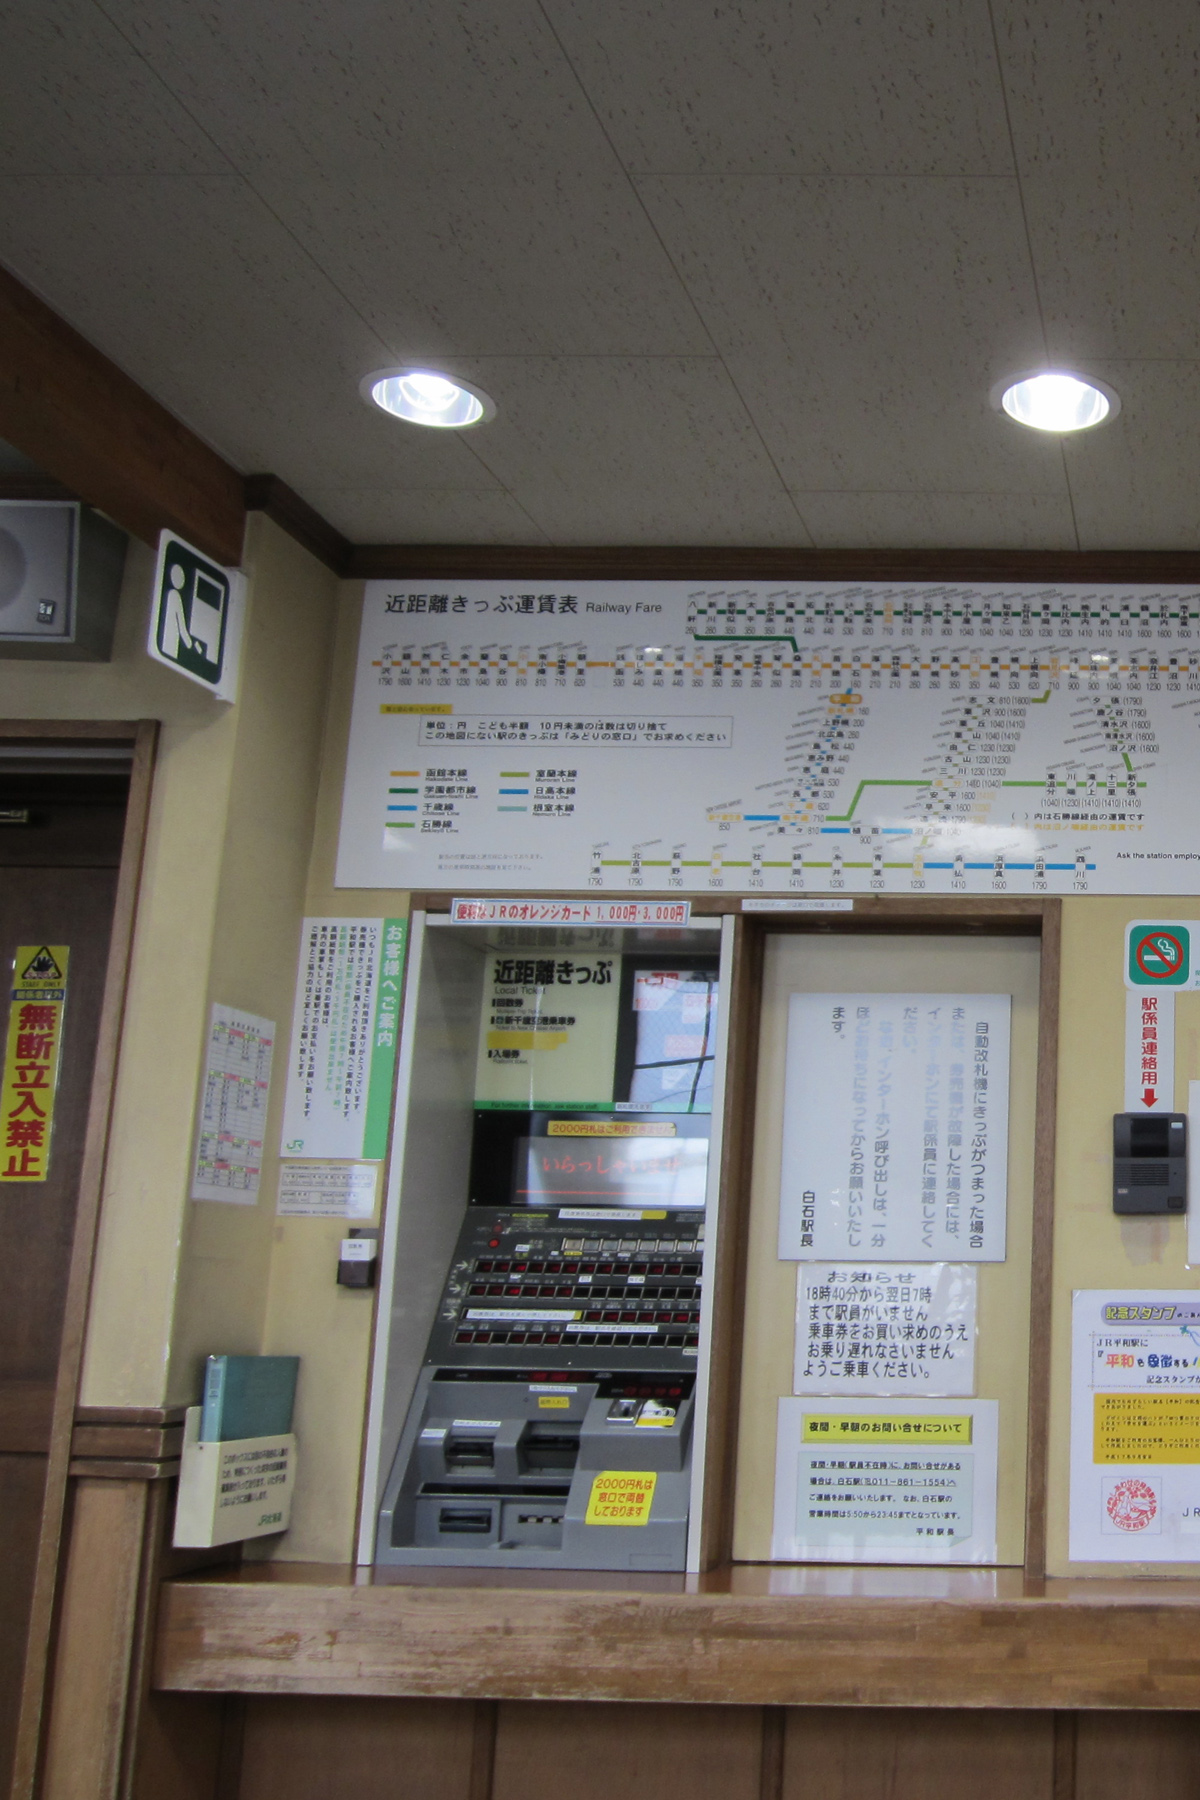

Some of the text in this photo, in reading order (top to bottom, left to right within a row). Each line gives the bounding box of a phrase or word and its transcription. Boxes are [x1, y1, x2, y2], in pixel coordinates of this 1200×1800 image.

[385, 594, 578, 614] 近距離きっぷ運賃表
[586, 602, 661, 614] Railway Fare
[478, 721, 529, 730] こども半額
[540, 721, 667, 731] 10円未満のは数は切り捨て
[425, 731, 726, 743] この地図にない駅のきっぷは「みどりの窓口」でお求めください
[426, 768, 467, 778] 函館本線
[536, 768, 577, 778] 室蘭本線
[425, 786, 476, 795] 学園都市線
[535, 786, 576, 795] 日高本線
[423, 803, 454, 812] 千歳線
[533, 804, 575, 813] 根室本線
[421, 819, 453, 829] 石勝線
[1116, 852, 1131, 860] Ask
[1132, 852, 1145, 860] the
[587, 878, 683, 887] 1790 1790 1790
[748, 879, 885, 888] 1410 1230 1230
[991, 881, 1088, 890] 1600 1790 1790
[494, 960, 613, 985] 近距離きっぷ
[377, 925, 402, 1048] お客様へご案内
[494, 986, 546, 994] Local Tickt
[831, 1006, 846, 1040] ます。
[1141, 997, 1158, 1085] 駅係員連絡用
[493, 1050, 519, 1058] 入場券
[2, 1004, 57, 1177] 無断立入禁止
[970, 1022, 989, 1249] 自動改札機にきっぷがつまった場合
[286, 1140, 304, 1150] JR
[800, 1190, 815, 1248] 白石駅長
[827, 1271, 917, 1284] お知らせ
[805, 1286, 932, 1303] 18時40分から翌日7時
[808, 1304, 928, 1321] まで駅員がいません
[1105, 1306, 1176, 1320] 記念スタンプ
[808, 1323, 968, 1341] 乗車券をお買い求めのうえ
[808, 1342, 955, 1359] お乗り遅れなさいません
[803, 1360, 931, 1379] ようご乗車ください。
[808, 1421, 962, 1434] 夜間・早朝のお問い合せについて
[596, 1479, 652, 1490] 2000円札は
[594, 1506, 643, 1517] しております
